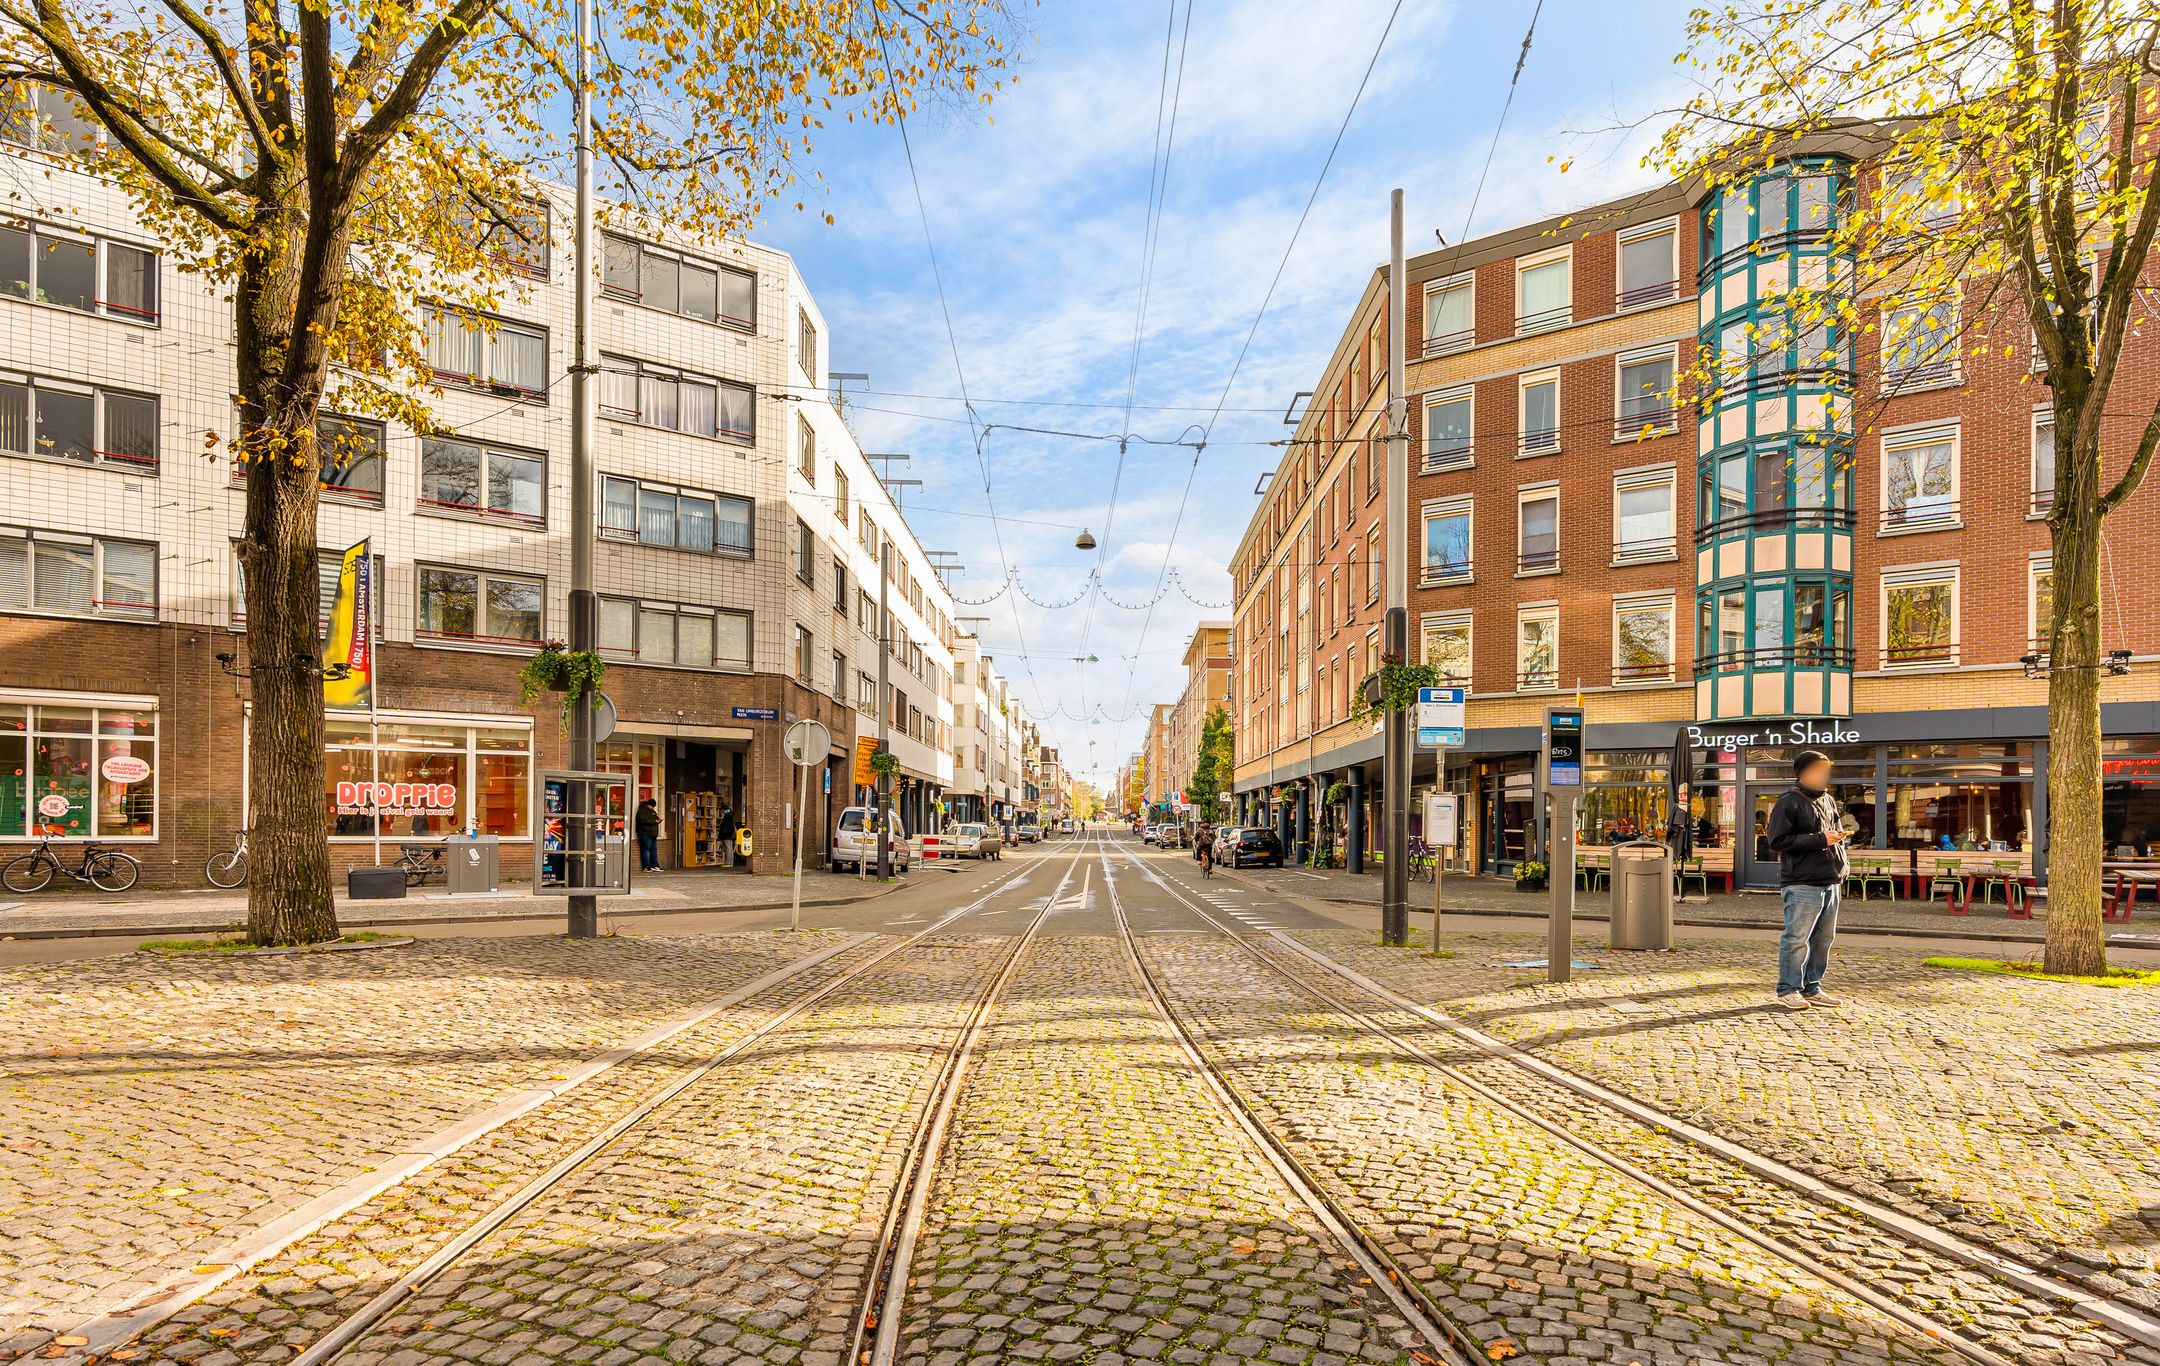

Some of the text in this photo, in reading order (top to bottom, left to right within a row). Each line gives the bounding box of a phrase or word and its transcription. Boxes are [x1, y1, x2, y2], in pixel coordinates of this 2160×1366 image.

[352, 558, 369, 665] 750 AMSTERDAM 750
[1687, 726, 1759, 753] Burger
[1789, 720, 1861, 745] Shake
[337, 806, 359, 815] Hier
[380, 806, 403, 815] afval
[426, 807, 454, 816] waard
